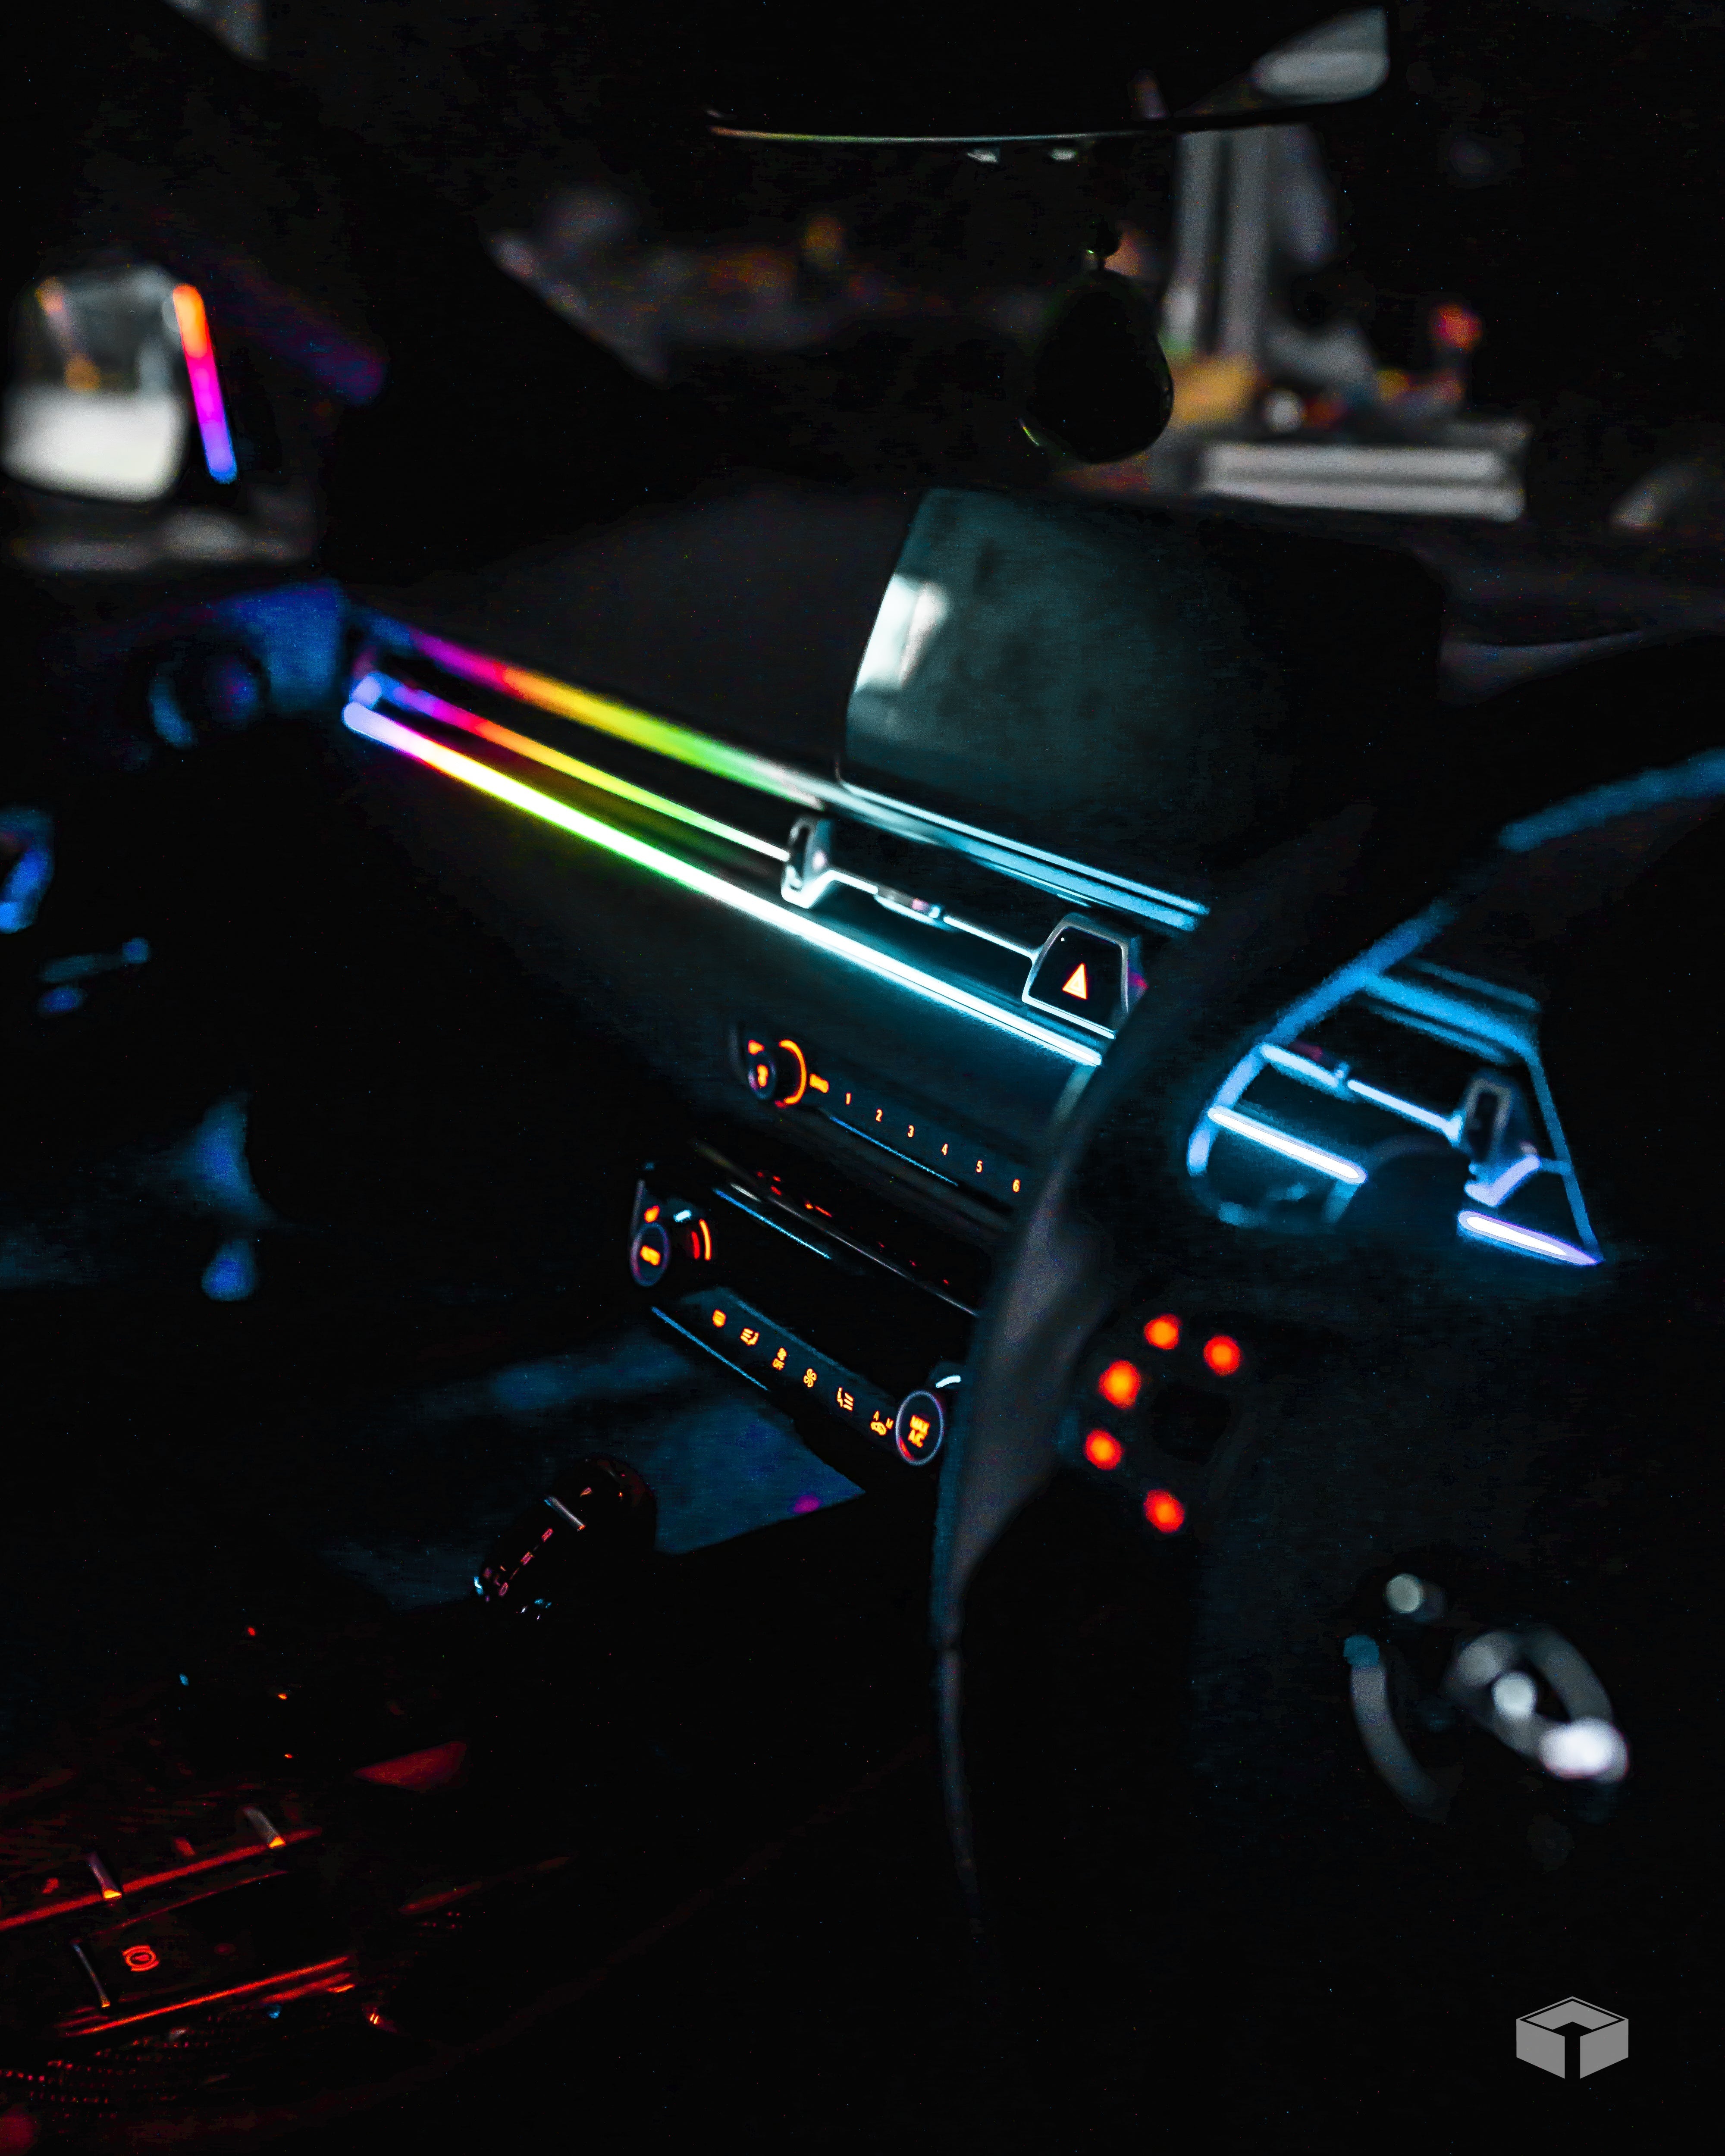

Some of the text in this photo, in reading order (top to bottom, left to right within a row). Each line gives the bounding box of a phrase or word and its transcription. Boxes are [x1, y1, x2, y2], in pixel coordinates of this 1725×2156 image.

[846, 1093, 1020, 1193] 1 2 3 4 5 6
